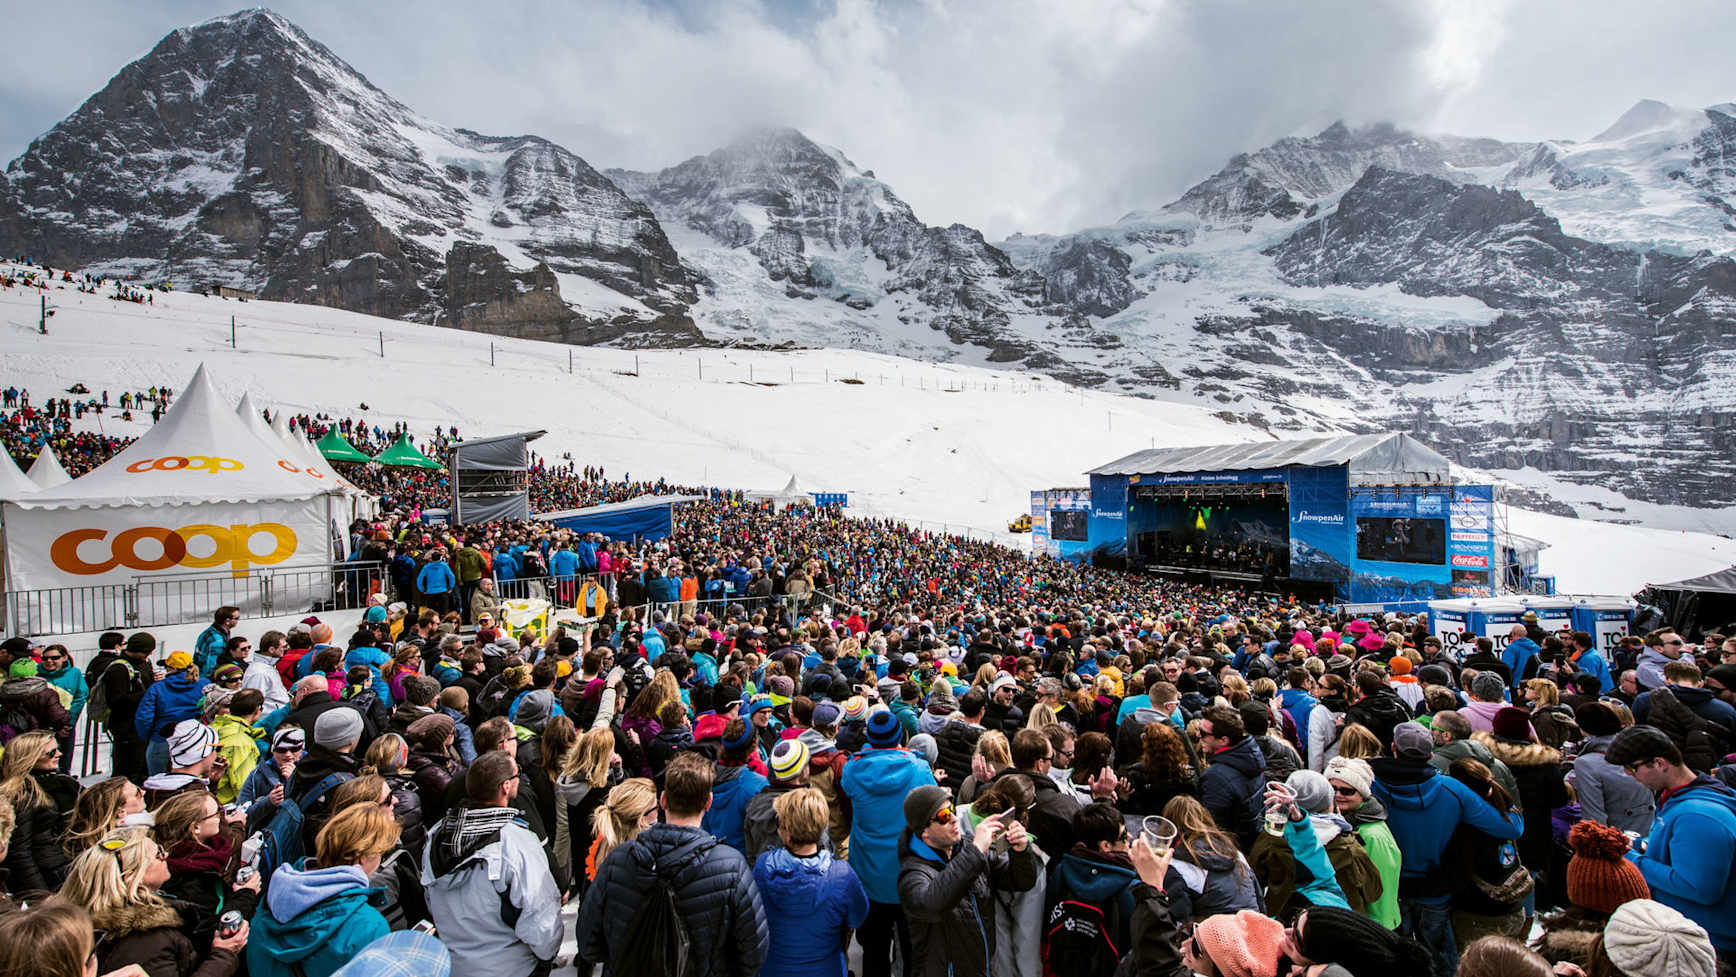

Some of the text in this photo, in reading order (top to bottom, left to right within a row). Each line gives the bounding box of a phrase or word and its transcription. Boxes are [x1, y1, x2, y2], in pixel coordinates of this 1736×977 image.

[126, 456, 245, 474] coop
[1292, 510, 1344, 523] SnowpenAir
[50, 522, 298, 578] coop
